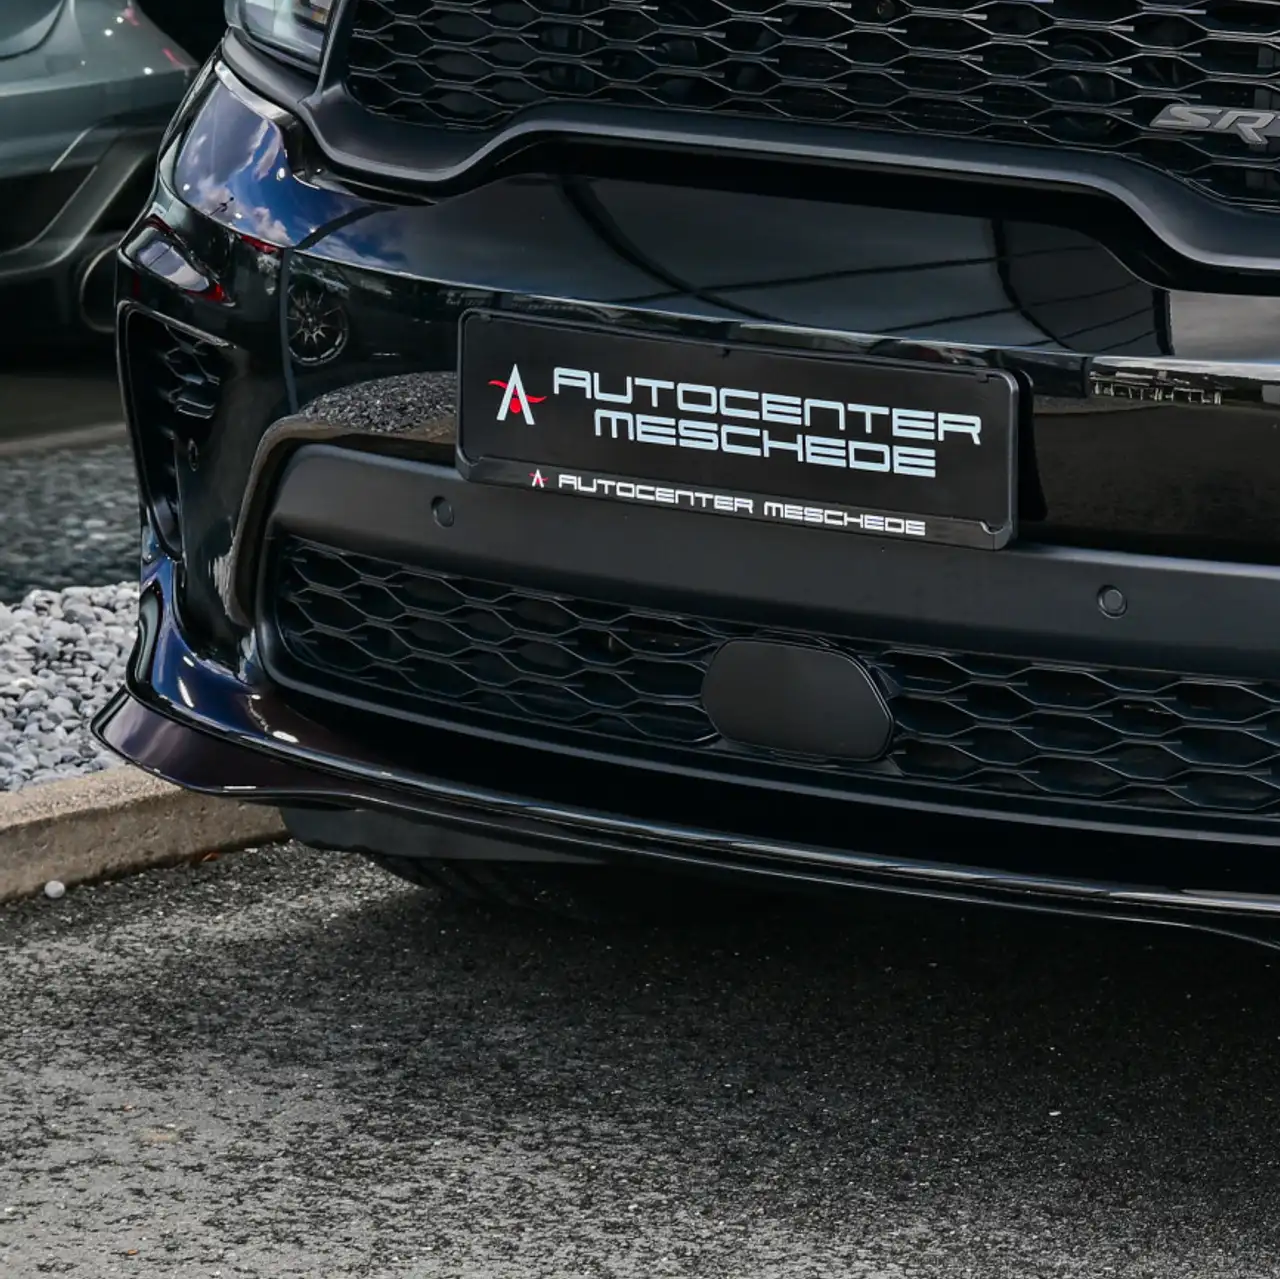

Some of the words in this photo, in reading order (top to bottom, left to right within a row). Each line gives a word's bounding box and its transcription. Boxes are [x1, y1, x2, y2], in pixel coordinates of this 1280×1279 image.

[553, 367, 982, 445] AUTOCENTER
[594, 408, 936, 478] MESCHEDE
[558, 473, 754, 515] AUTOCENTER
[763, 501, 926, 536] MESCHEDE
